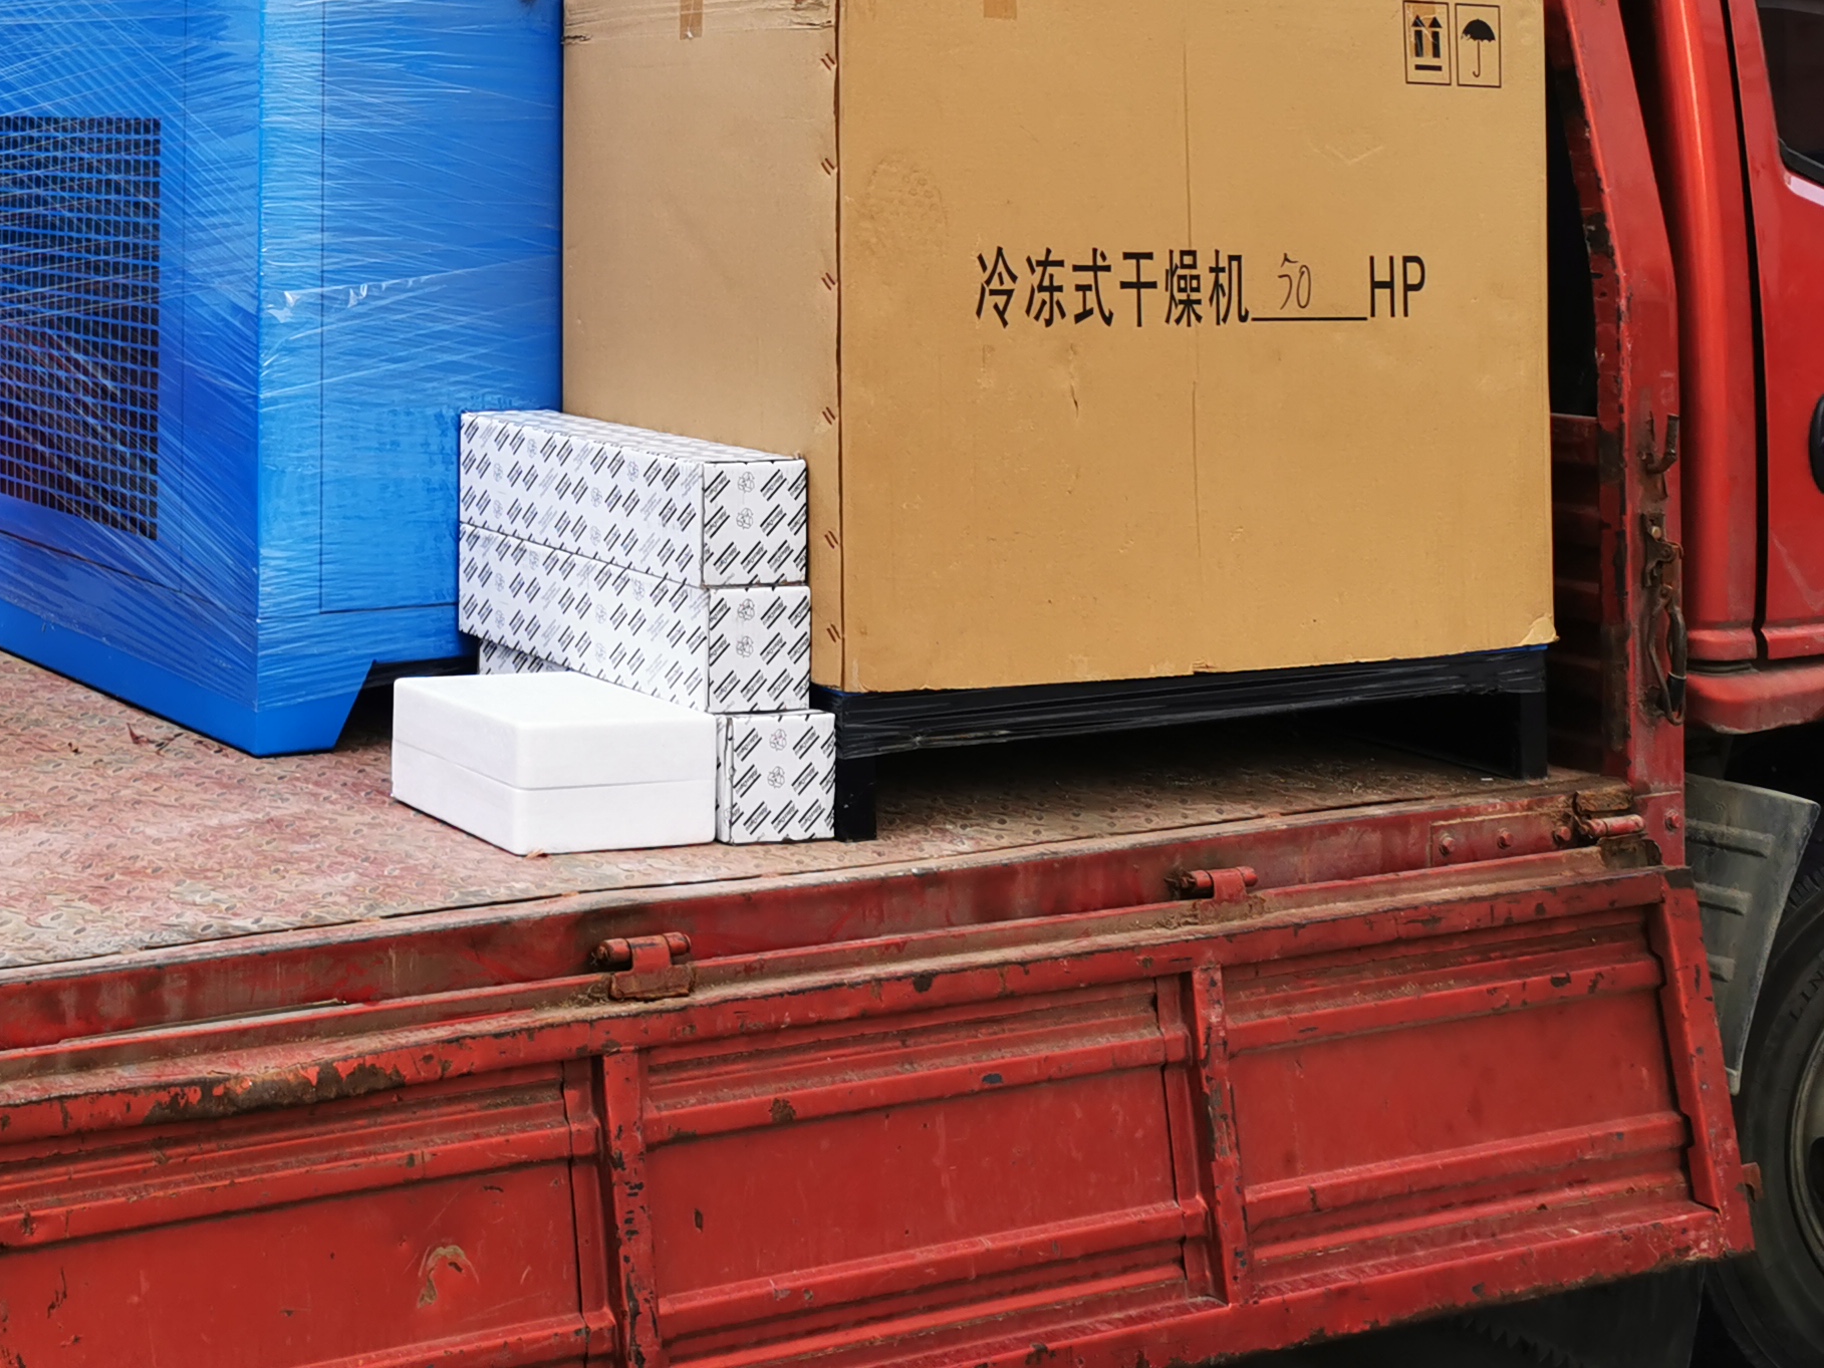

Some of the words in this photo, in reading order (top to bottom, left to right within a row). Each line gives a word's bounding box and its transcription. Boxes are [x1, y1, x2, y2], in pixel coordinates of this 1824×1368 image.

[976, 246, 1250, 328] 冷冻式干燥机
[1277, 252, 1313, 310] 50
[1368, 254, 1426, 318] HP
